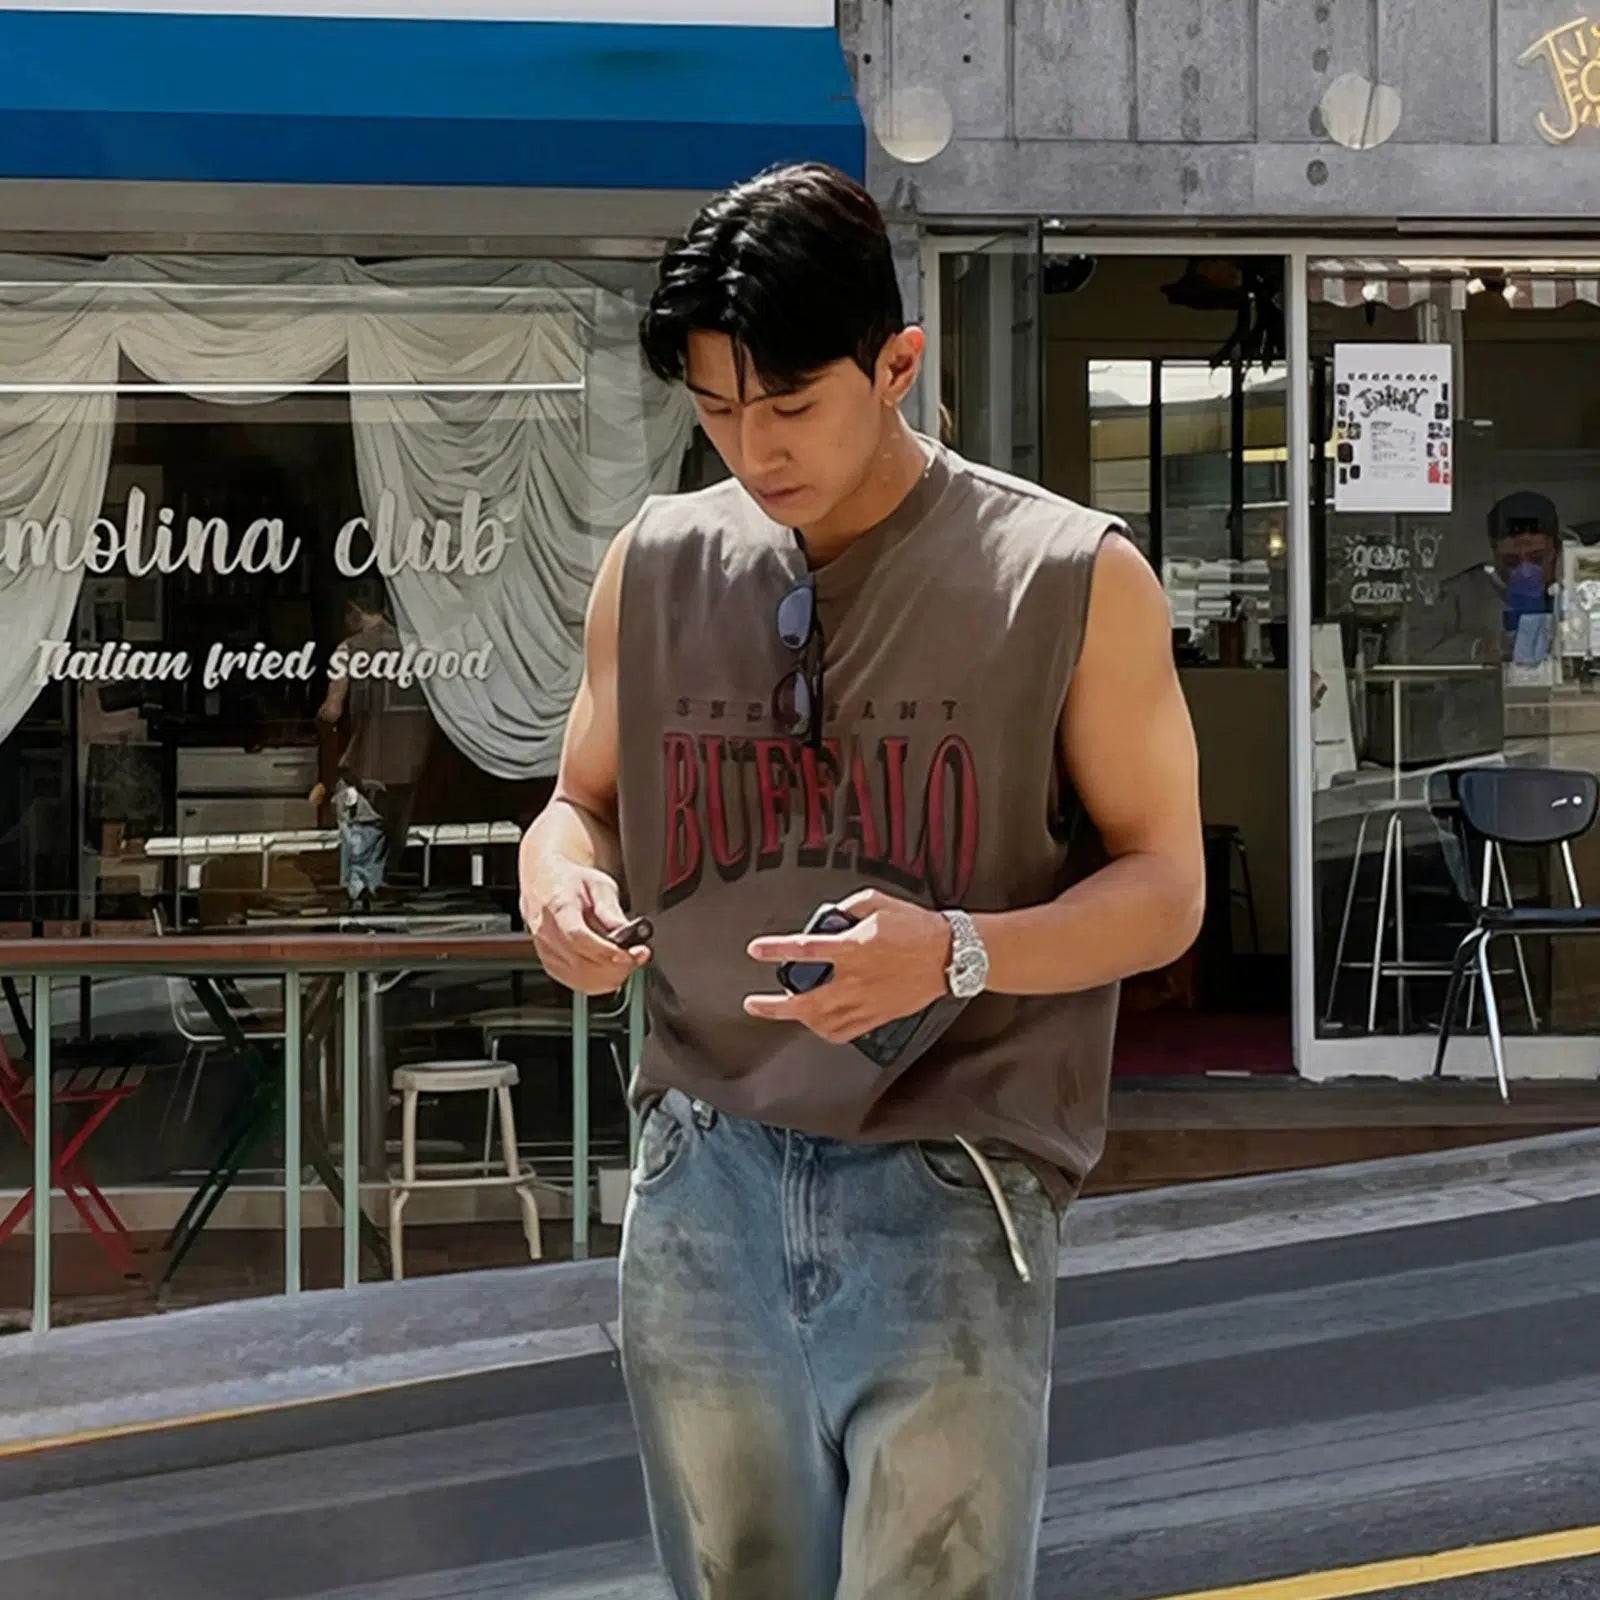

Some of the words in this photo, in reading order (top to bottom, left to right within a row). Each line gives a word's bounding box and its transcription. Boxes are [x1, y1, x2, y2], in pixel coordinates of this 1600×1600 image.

[0, 486, 302, 576] molina
[334, 487, 514, 577] club
[35, 639, 192, 687] Italian
[203, 641, 316, 690] fried
[327, 641, 494, 689] seafood
[657, 731, 979, 912] BUFFALO
